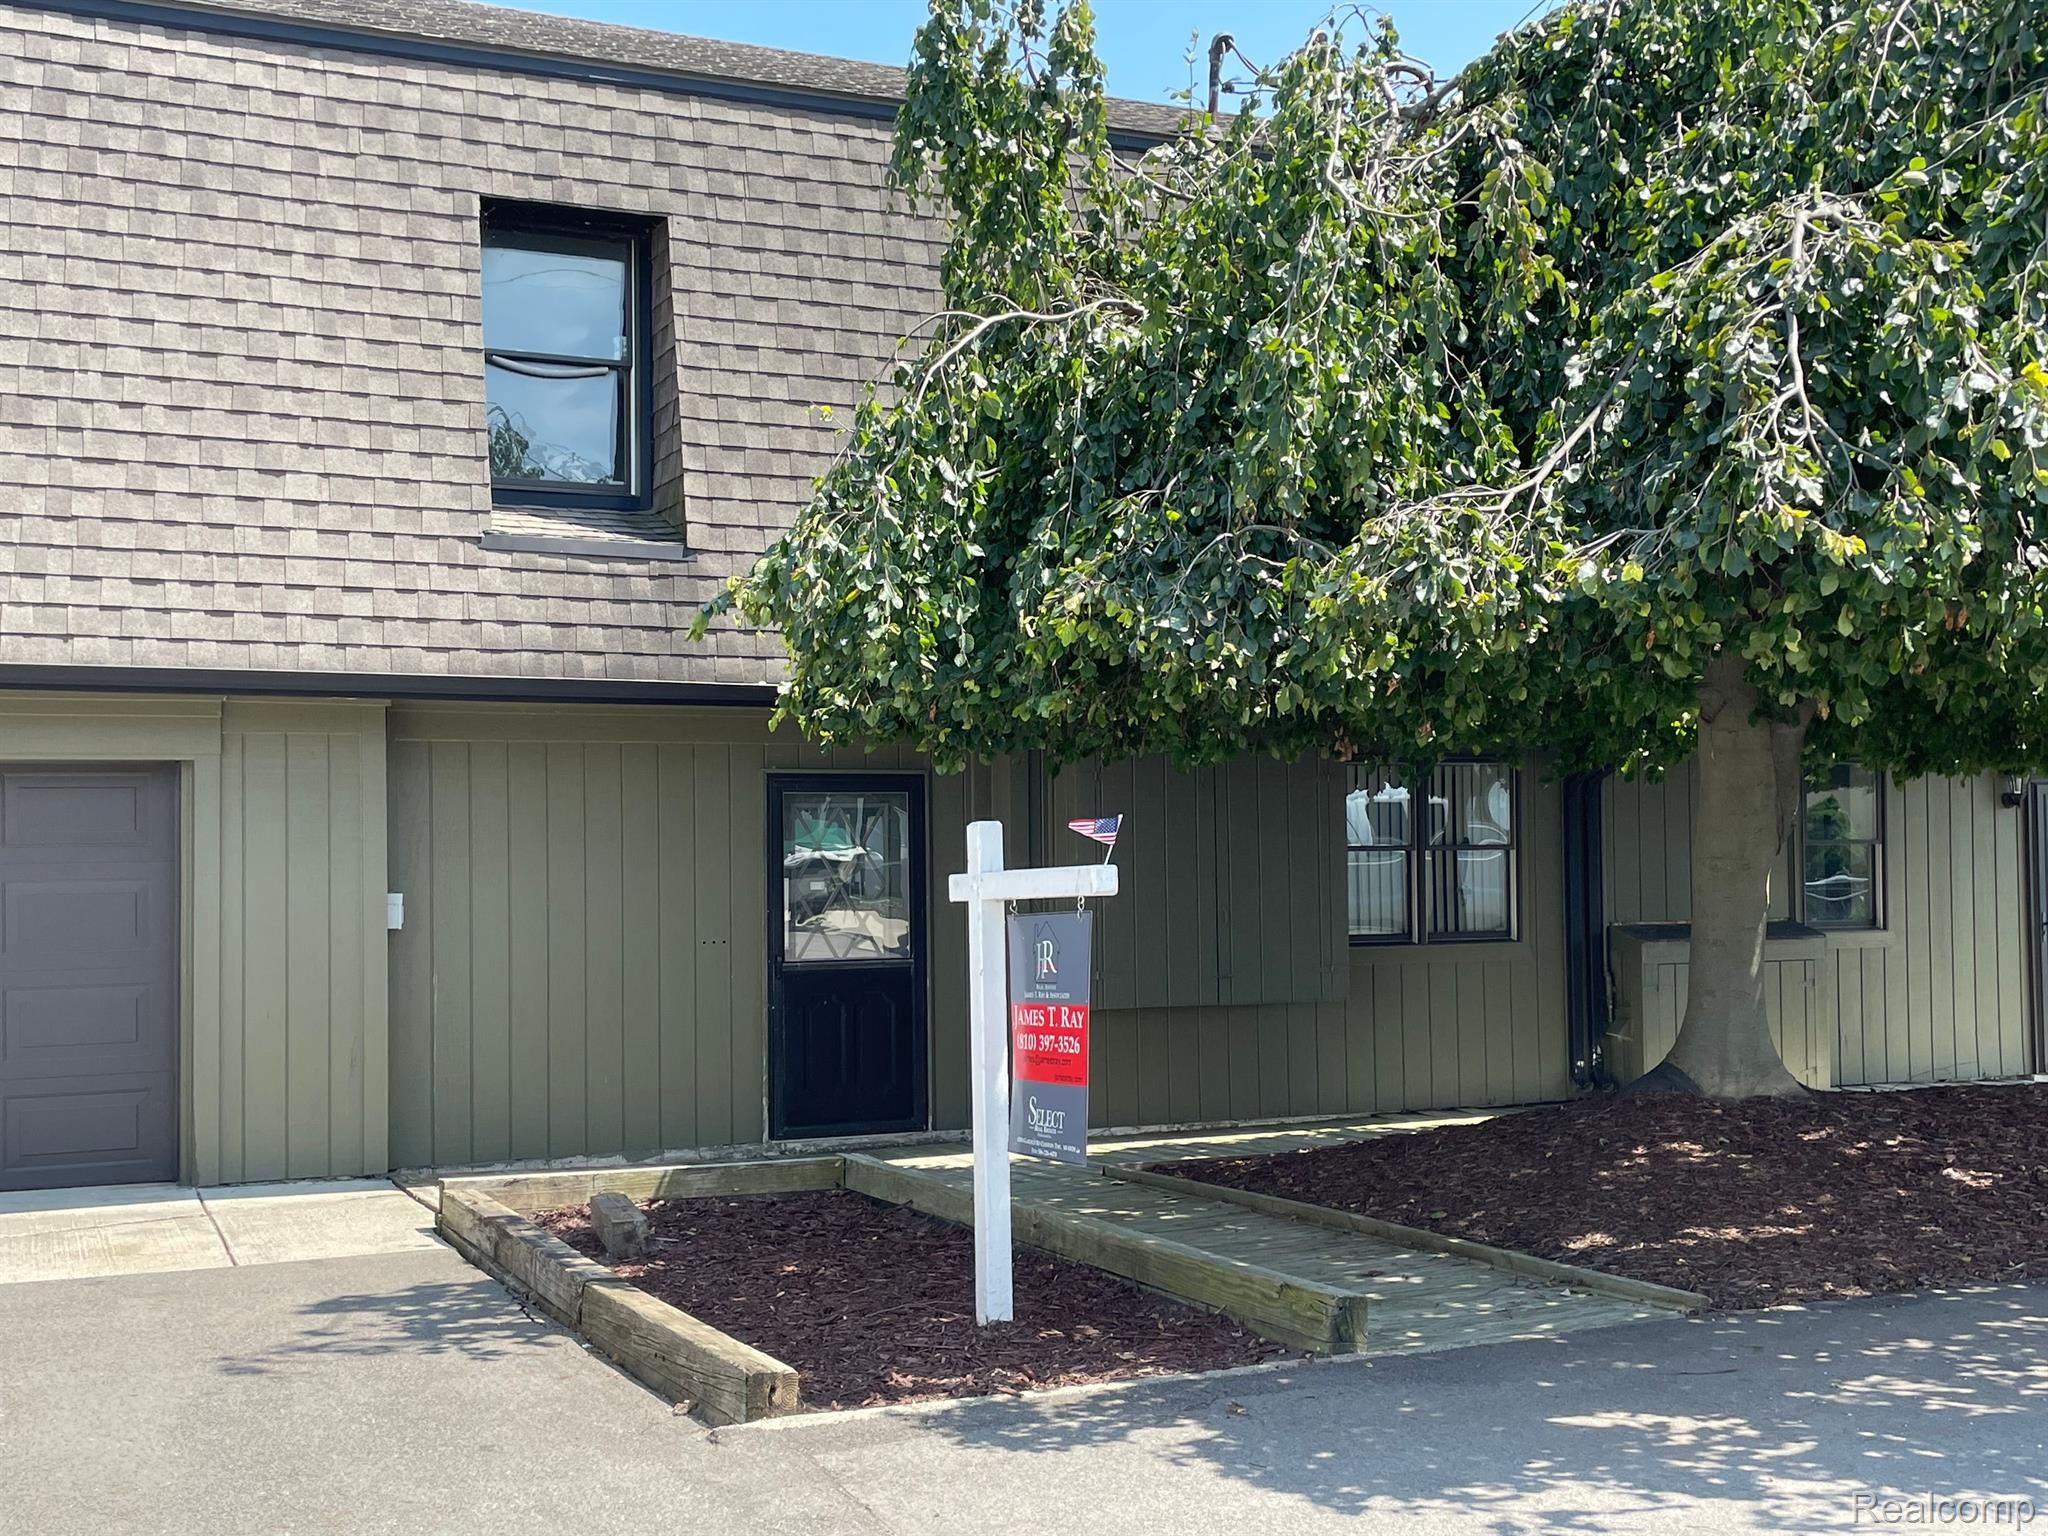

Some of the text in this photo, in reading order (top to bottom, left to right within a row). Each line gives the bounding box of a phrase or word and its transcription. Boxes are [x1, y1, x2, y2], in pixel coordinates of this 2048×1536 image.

[1014, 1005, 1084, 1030] JAMES T. RAY
[1017, 1032, 1080, 1054] (810) 397-3526
[1028, 1095, 1065, 1129] SELECT
